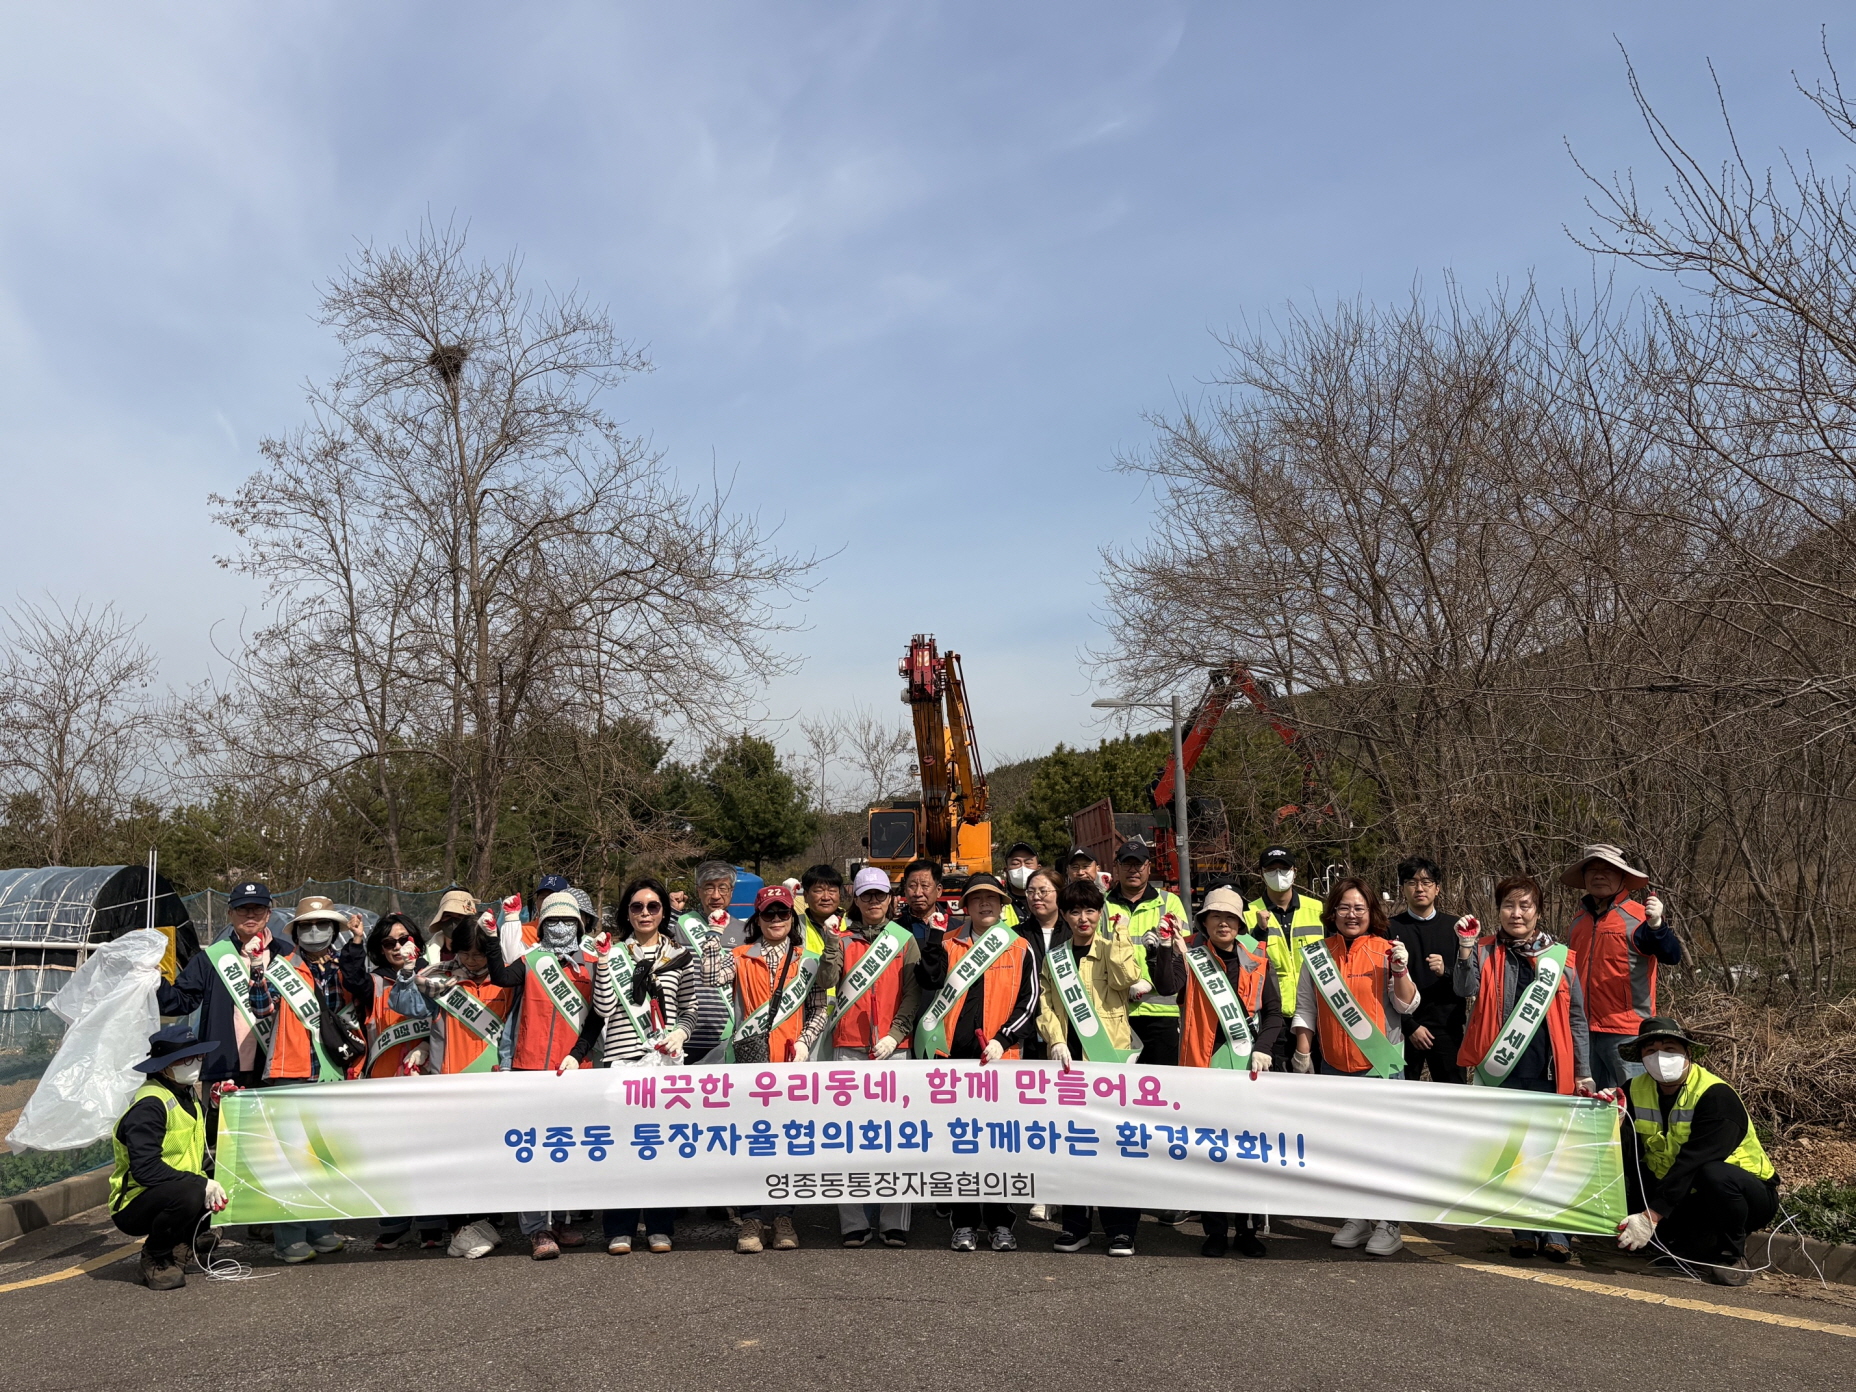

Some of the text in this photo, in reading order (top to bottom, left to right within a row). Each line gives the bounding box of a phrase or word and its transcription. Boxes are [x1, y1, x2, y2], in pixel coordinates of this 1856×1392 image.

[848, 942, 892, 991] 청렴한
[957, 934, 1003, 981] 청렴한
[541, 964, 584, 1017] 청렴한
[931, 983, 957, 1019] 마음
[1052, 944, 1092, 1023] 렴한 마음
[1188, 948, 1248, 1041] 청렴한 마음
[1304, 943, 1335, 985] 청렴한
[1330, 989, 1362, 1027] 마음
[377, 1020, 430, 1050] 청렴한
[485, 1019, 503, 1042] 세
[1493, 967, 1556, 1066] 청렴한 세상
[623, 1068, 1181, 1111] 깨끗한 우리동네, 함께 만들어요.
[504, 1117, 1306, 1168] 영종동 통장자율협의회와 함께하는 환경정화!!
[766, 1171, 1036, 1199] 영종동통장자율협의회
